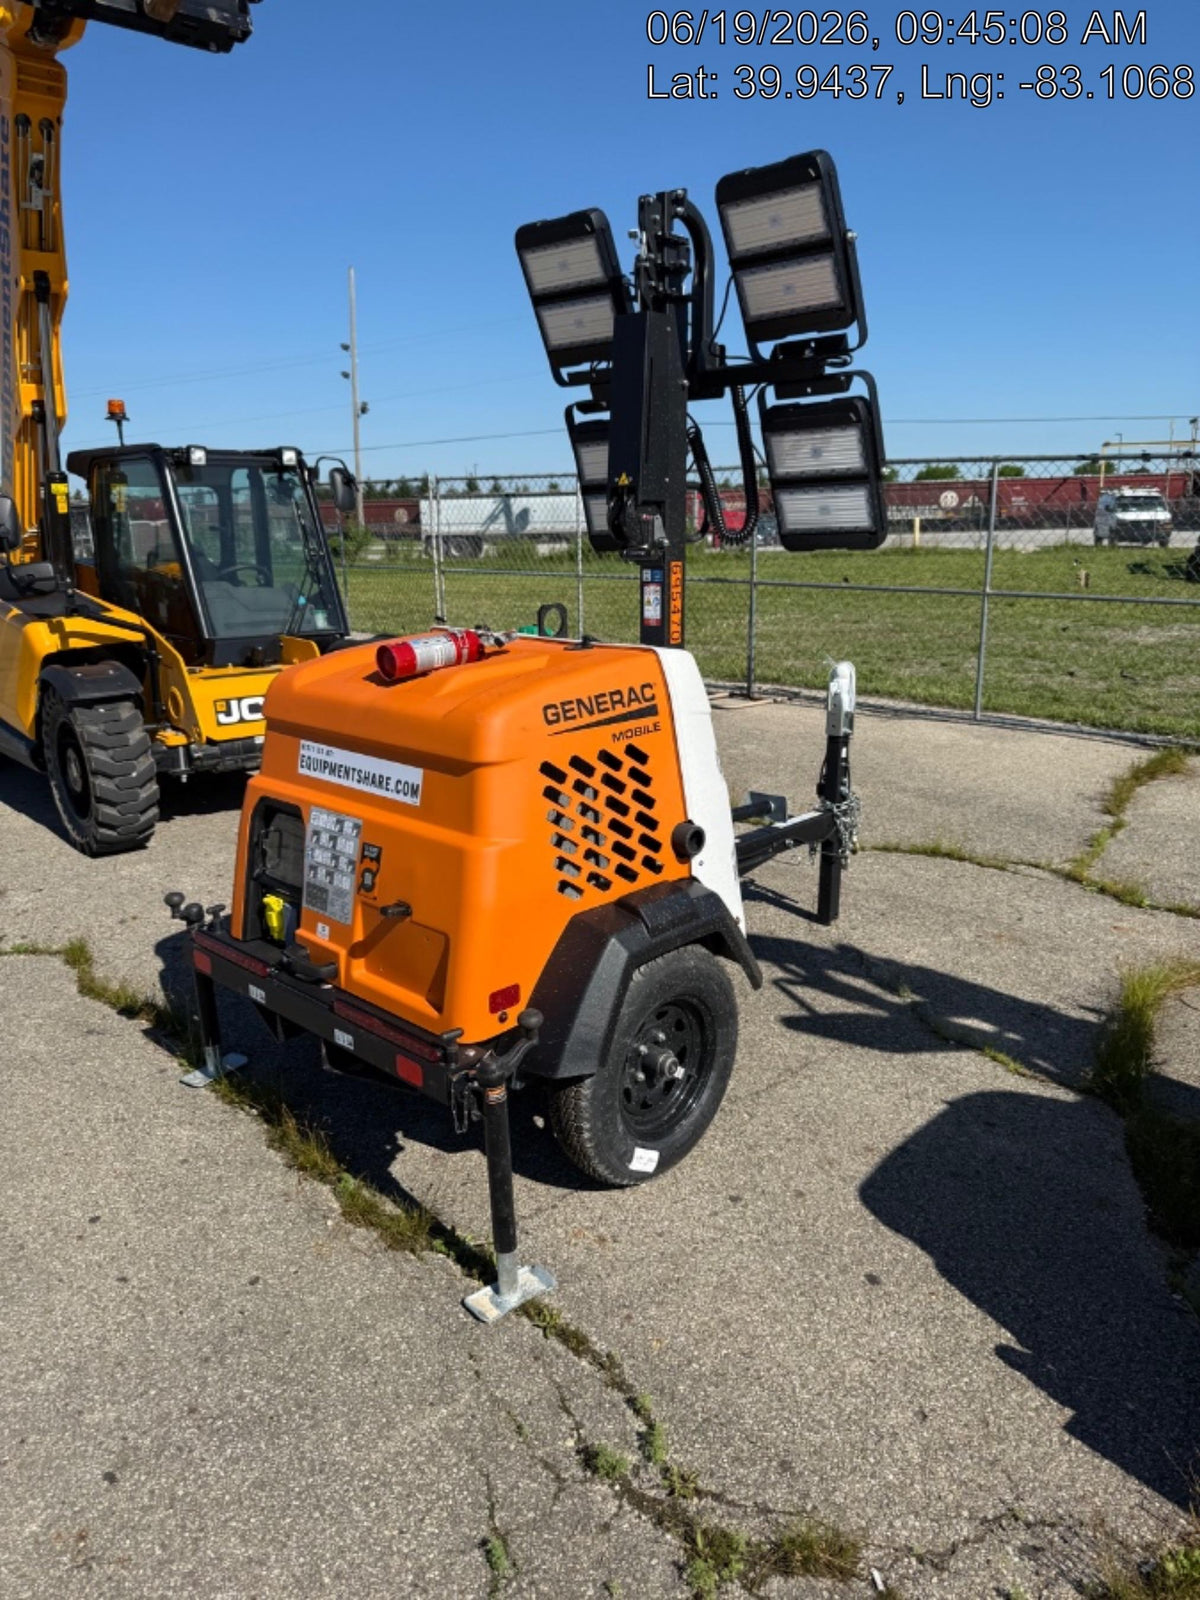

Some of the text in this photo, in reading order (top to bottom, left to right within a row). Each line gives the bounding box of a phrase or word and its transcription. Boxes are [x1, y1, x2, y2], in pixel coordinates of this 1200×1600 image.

[217, 696, 265, 724] JC
[542, 682, 656, 726] GENERAC
[611, 721, 662, 743] MOBILE
[299, 754, 420, 799] EQUIPMENTSHARE.COM
